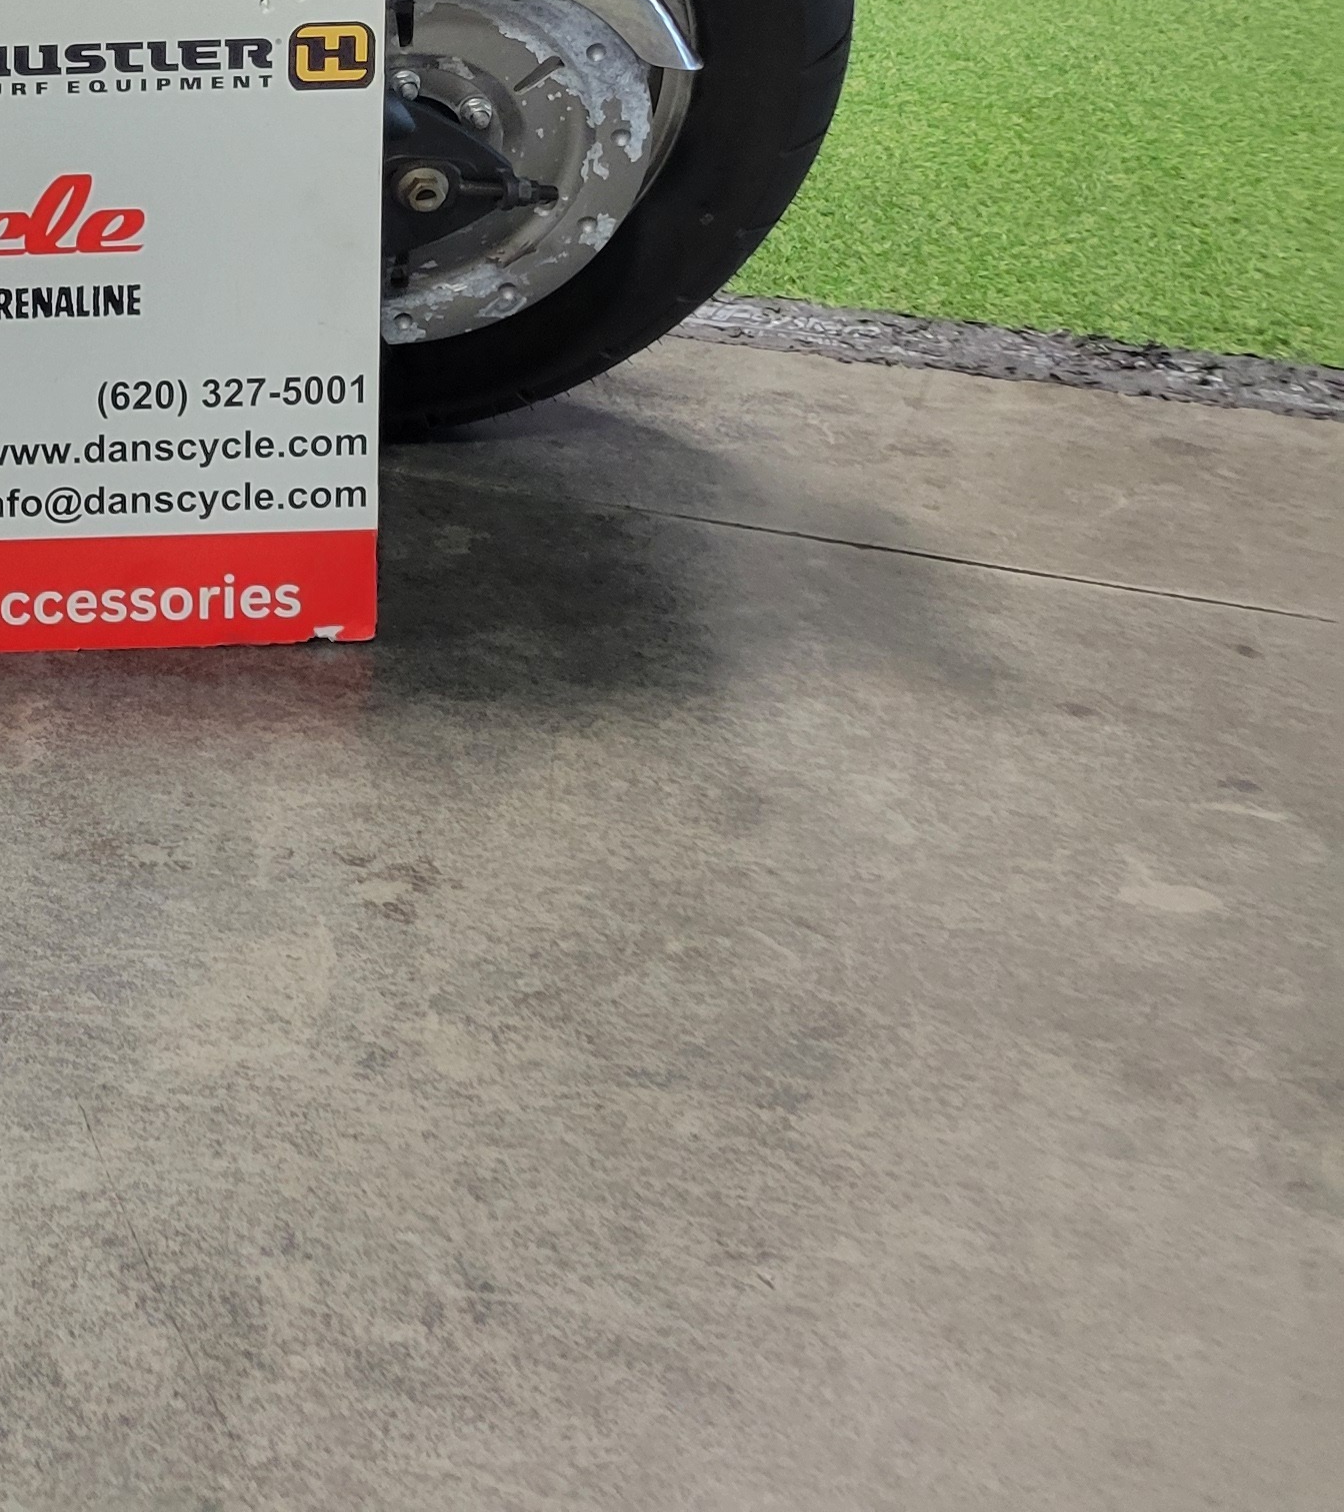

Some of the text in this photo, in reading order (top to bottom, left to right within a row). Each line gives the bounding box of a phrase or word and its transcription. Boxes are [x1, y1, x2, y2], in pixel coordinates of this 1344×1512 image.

[67, 74, 274, 95] EQUIPMENT
[96, 374, 367, 419] (620) 327-5001
